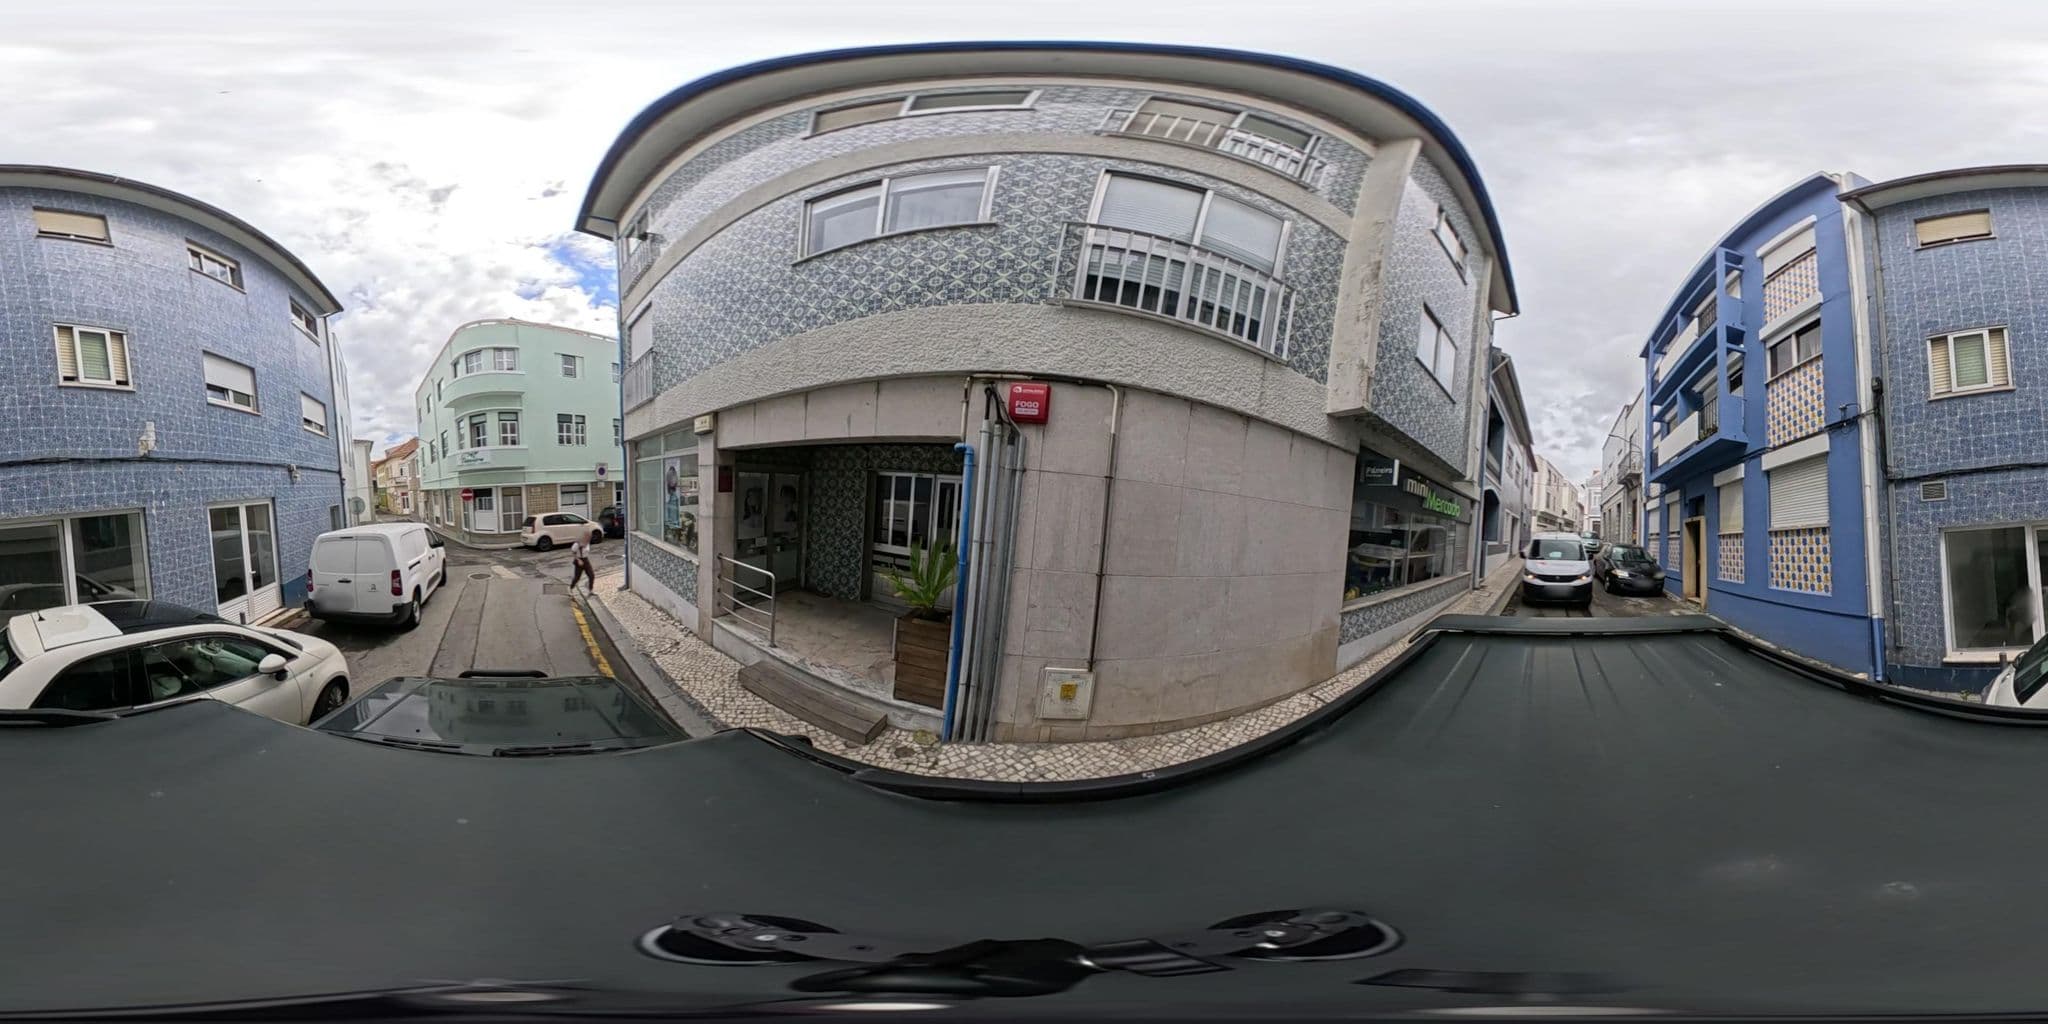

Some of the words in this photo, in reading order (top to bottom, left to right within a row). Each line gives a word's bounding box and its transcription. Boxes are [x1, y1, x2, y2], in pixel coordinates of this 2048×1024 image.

[1015, 400, 1039, 409] FOGO
[1407, 477, 1429, 498] mini
[1426, 490, 1461, 518] Mercado
